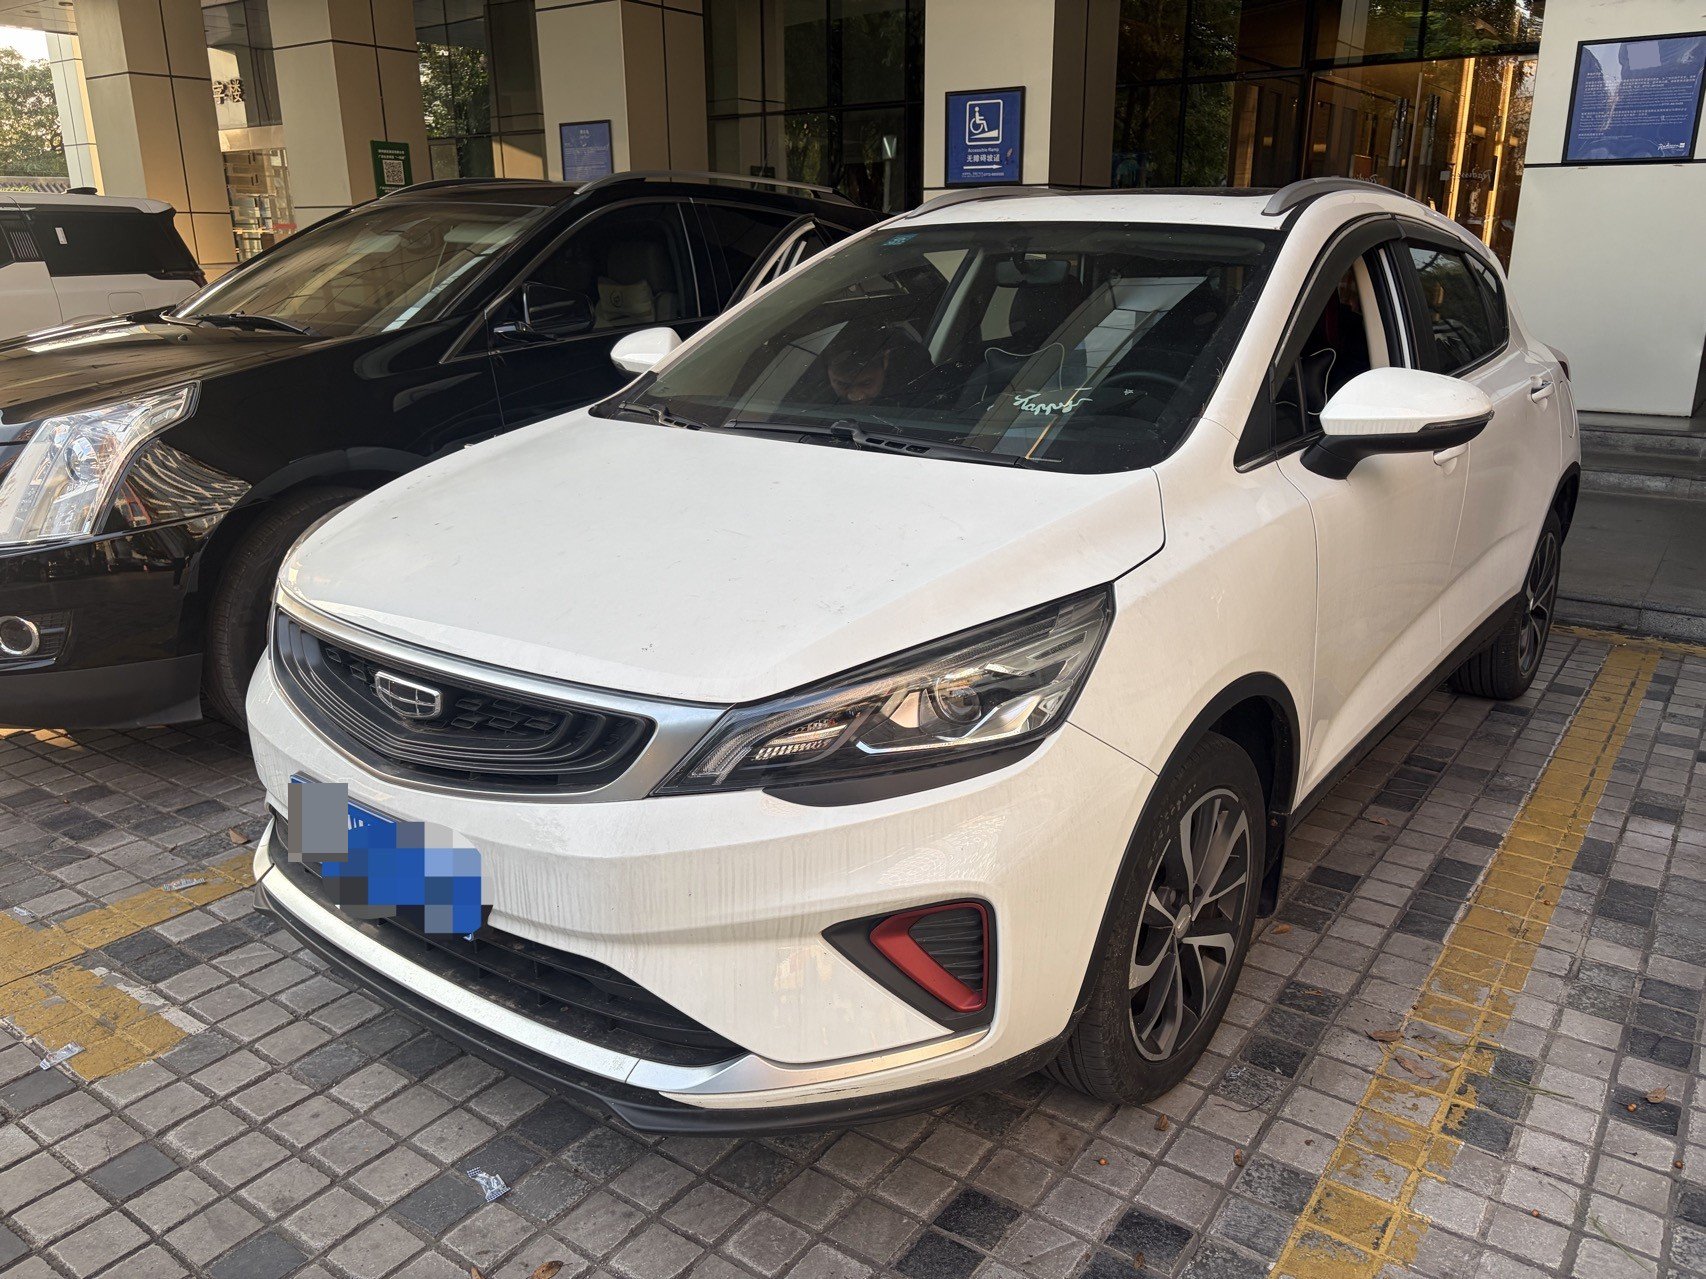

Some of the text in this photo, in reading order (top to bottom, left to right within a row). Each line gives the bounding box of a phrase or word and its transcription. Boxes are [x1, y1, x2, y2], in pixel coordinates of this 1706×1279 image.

[966, 154, 1000, 162] 无障碍坡道
